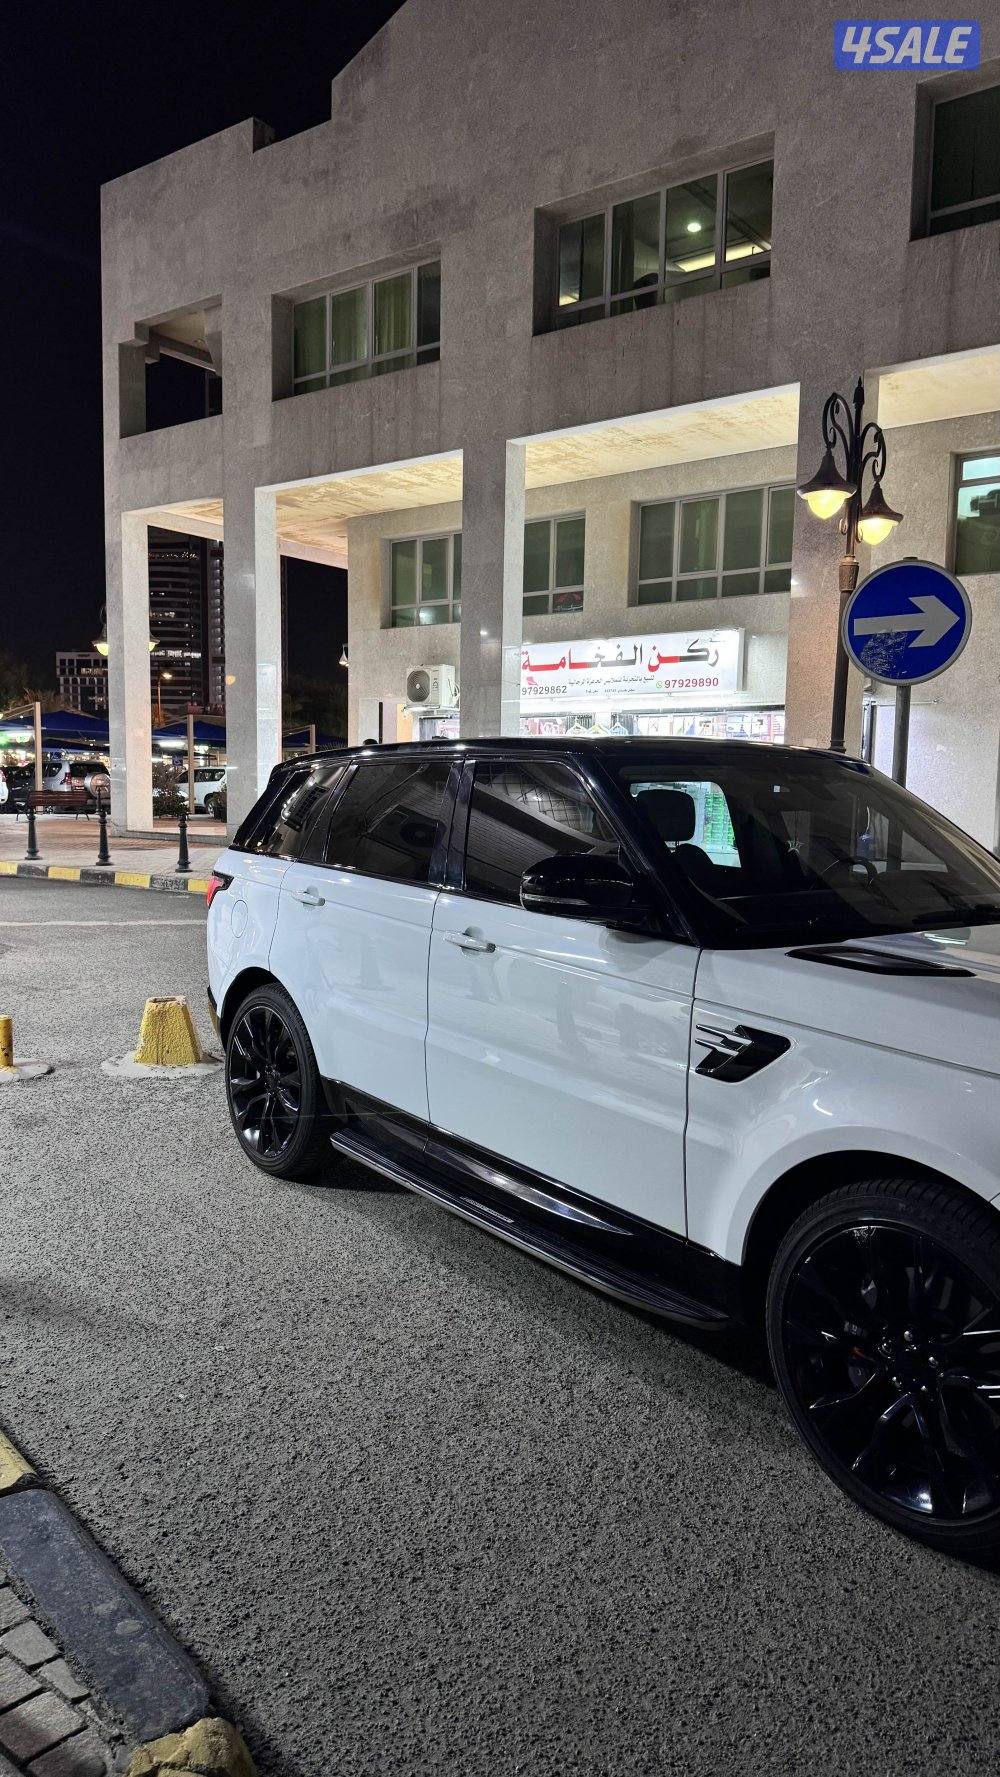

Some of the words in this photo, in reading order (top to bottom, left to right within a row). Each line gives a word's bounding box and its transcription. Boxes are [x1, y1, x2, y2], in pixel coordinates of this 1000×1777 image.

[520, 643, 643, 672] الفخامة
[647, 638, 719, 672] ركن
[521, 685, 567, 696] 97929862
[664, 677, 719, 689] 97929890
